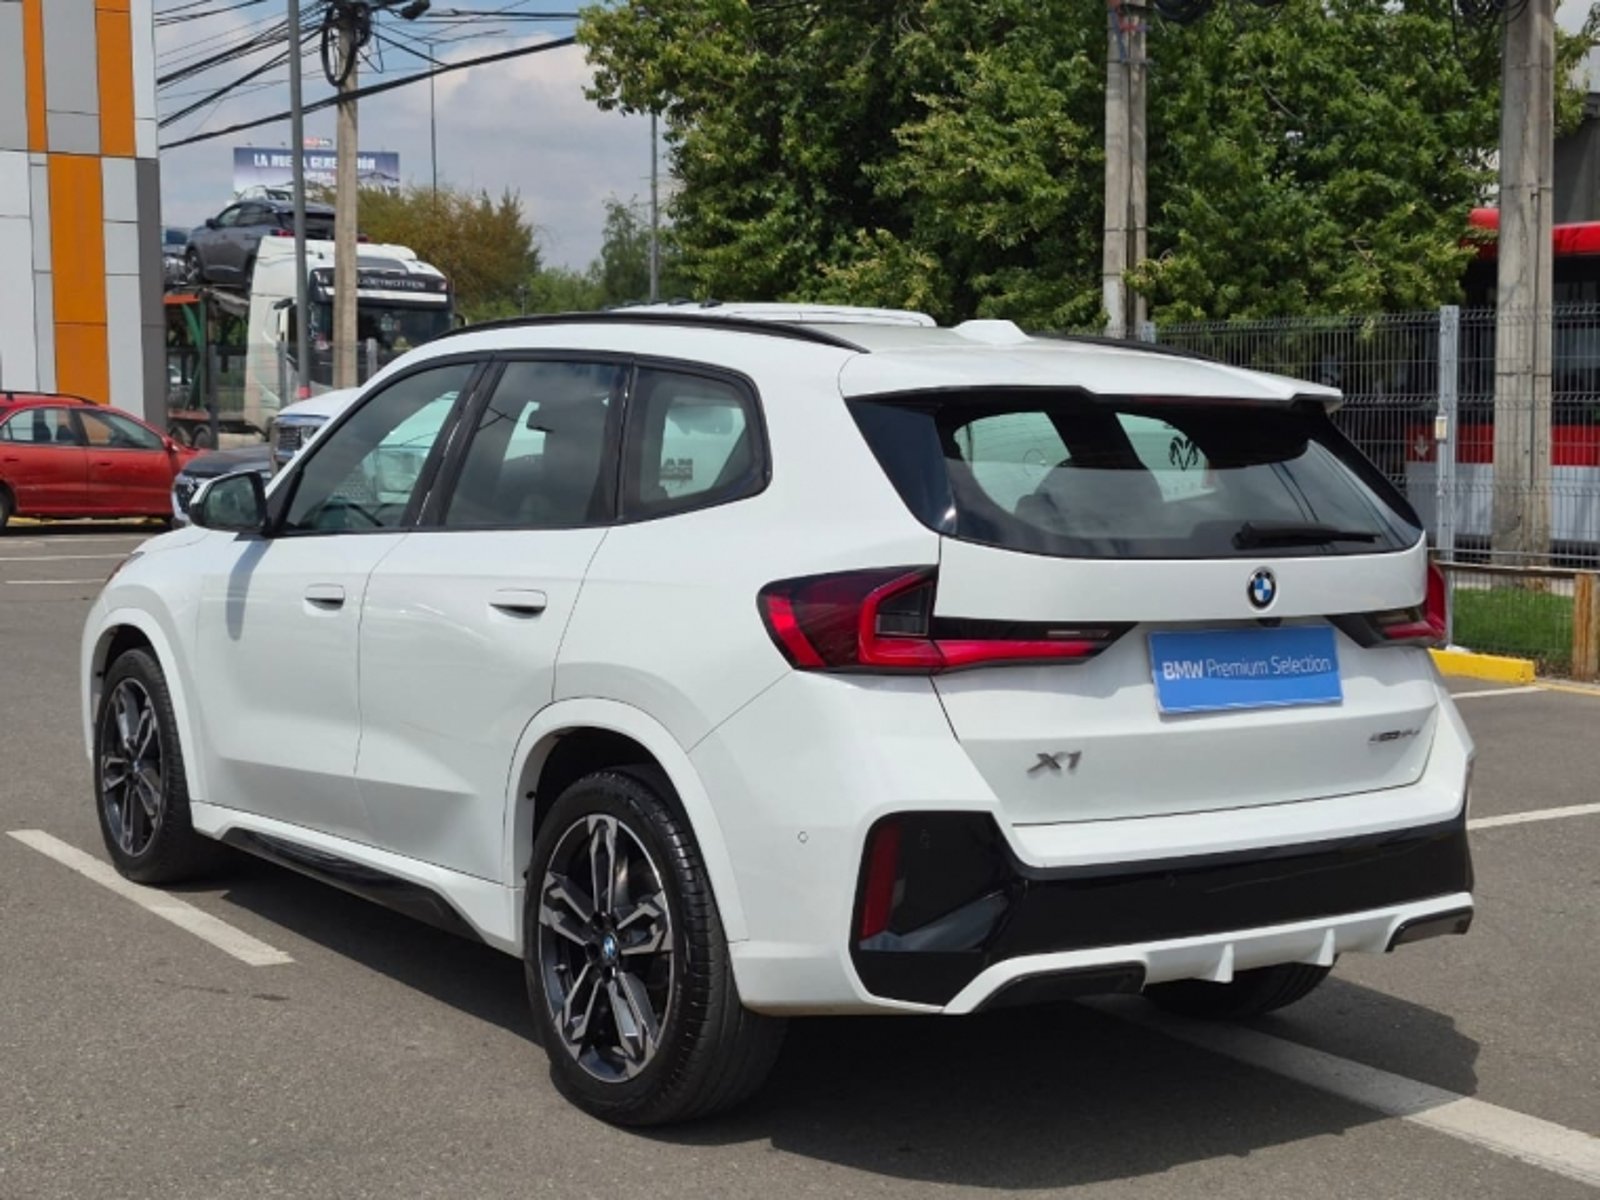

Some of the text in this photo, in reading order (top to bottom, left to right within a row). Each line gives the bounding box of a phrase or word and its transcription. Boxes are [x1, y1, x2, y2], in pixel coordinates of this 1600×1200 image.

[254, 153, 269, 168] LA
[271, 154, 308, 169] NUEA
[1162, 654, 1332, 681] BMW Premium Selection
[1026, 750, 1082, 774] X1
